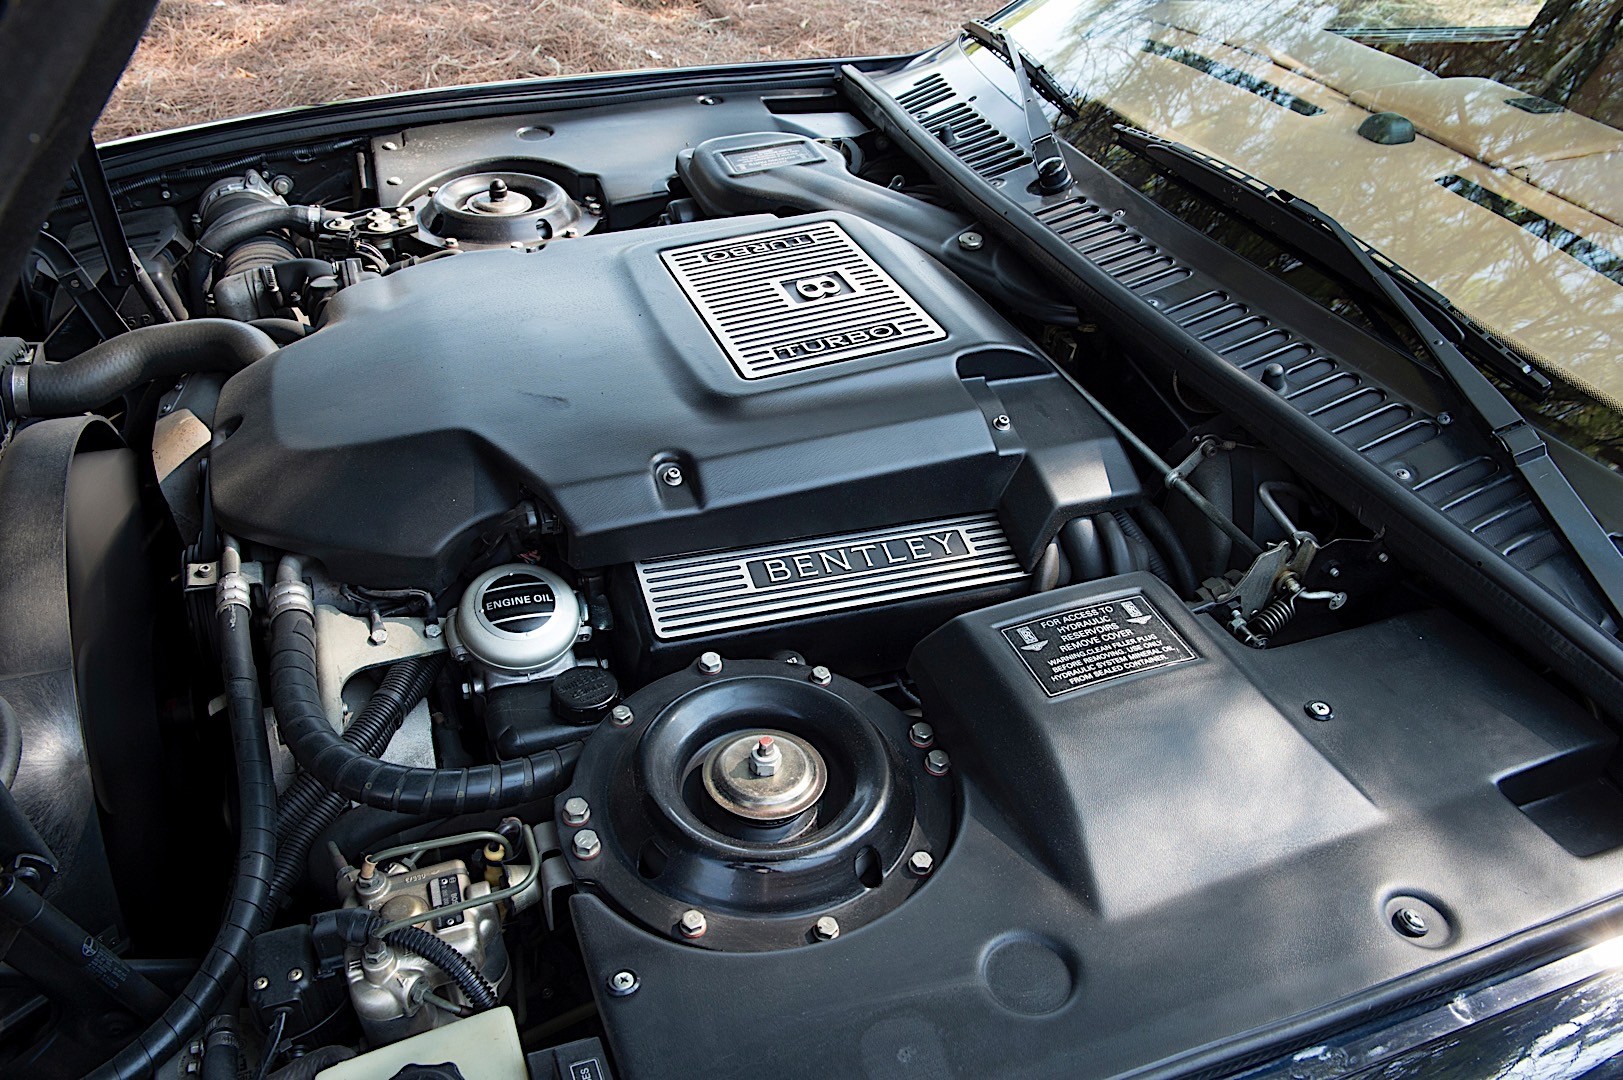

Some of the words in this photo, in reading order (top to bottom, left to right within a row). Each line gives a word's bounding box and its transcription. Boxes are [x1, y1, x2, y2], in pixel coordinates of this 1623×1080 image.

[707, 236, 811, 261] TURBO
[775, 325, 894, 357] TURBO
[764, 532, 955, 584] BENTLEY
[486, 594, 531, 611] ENGINE
[535, 593, 554, 603] OIL
[1040, 618, 1061, 629] FOR
[1063, 609, 1099, 623] ACCESS
[1098, 606, 1114, 614] TO
[1056, 615, 1111, 634] HYDRAULIC
[1059, 636, 1101, 653] REMOVE
[1101, 628, 1134, 642] COVER
[1060, 622, 1120, 642] RESERVOIRS
[1112, 638, 1137, 649] FILLER
[1136, 633, 1158, 643] PLUG
[1051, 664, 1096, 682] HYDRAULIC
[1096, 655, 1128, 669] SYSTEM
[1127, 648, 1163, 661] MINERAL
[1052, 659, 1083, 674] BEFORE
[1126, 644, 1143, 653] USE
[1143, 639, 1163, 649] ONLY
[1069, 672, 1094, 685] FROM
[1093, 664, 1124, 678] SEALED
[580, 1066, 590, 1080] ES
